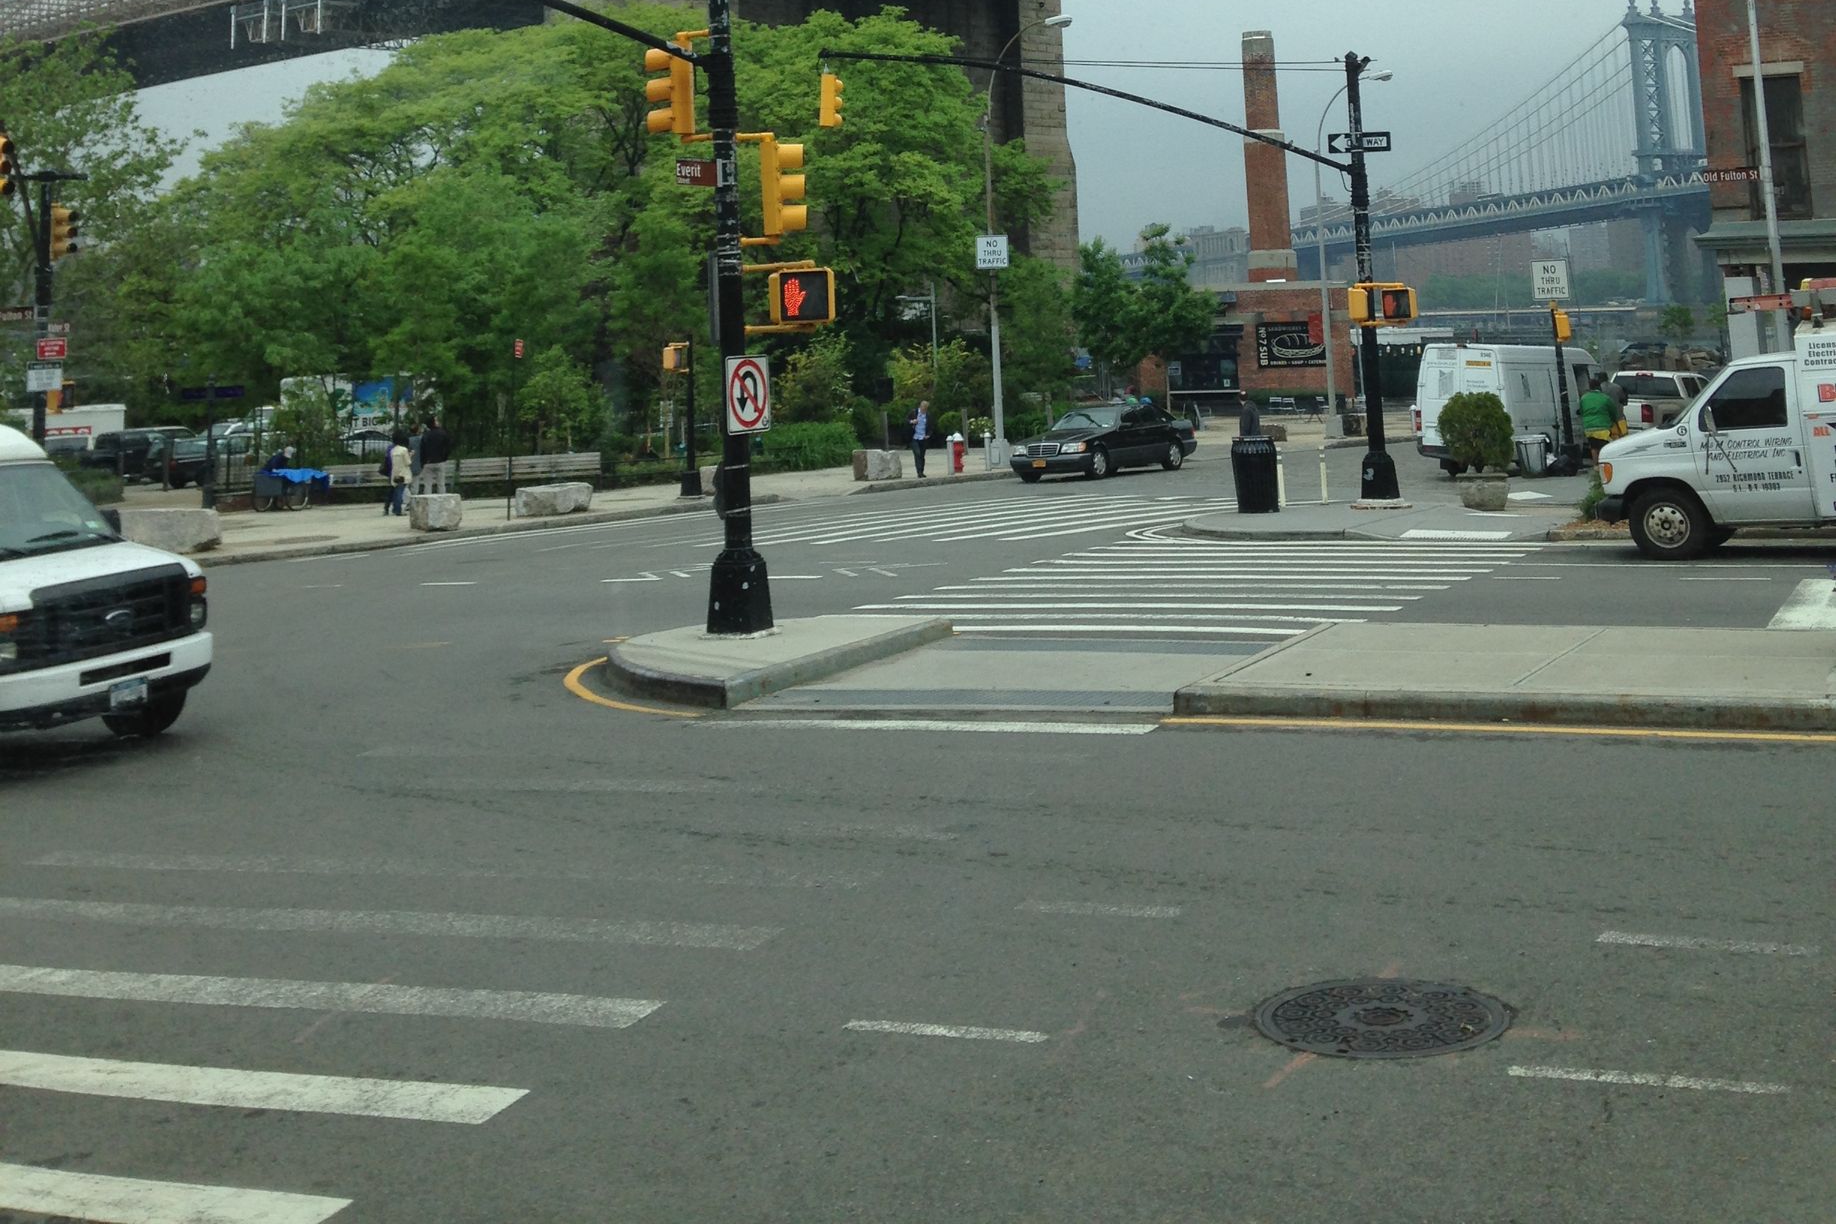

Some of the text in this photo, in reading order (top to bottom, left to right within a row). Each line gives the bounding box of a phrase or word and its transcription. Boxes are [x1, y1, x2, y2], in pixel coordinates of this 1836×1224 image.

[1366, 138, 1384, 146] WAY
[676, 163, 701, 177] Everit
[1703, 170, 1758, 182] Old Fulton St
[1542, 265, 1556, 274] NO
[1541, 277, 1560, 285] THRU
[1537, 287, 1566, 295] TRAFFIC
[1259, 346, 1269, 366] SUB
[1727, 439, 1760, 449] CONTROL
[1764, 437, 1793, 446] WIRING
[1708, 452, 1724, 461] AND
[1727, 450, 1768, 460] ELECTRICAL
[1733, 472, 1766, 482] RICHMOND
[1768, 471, 1794, 480] TERRACE
